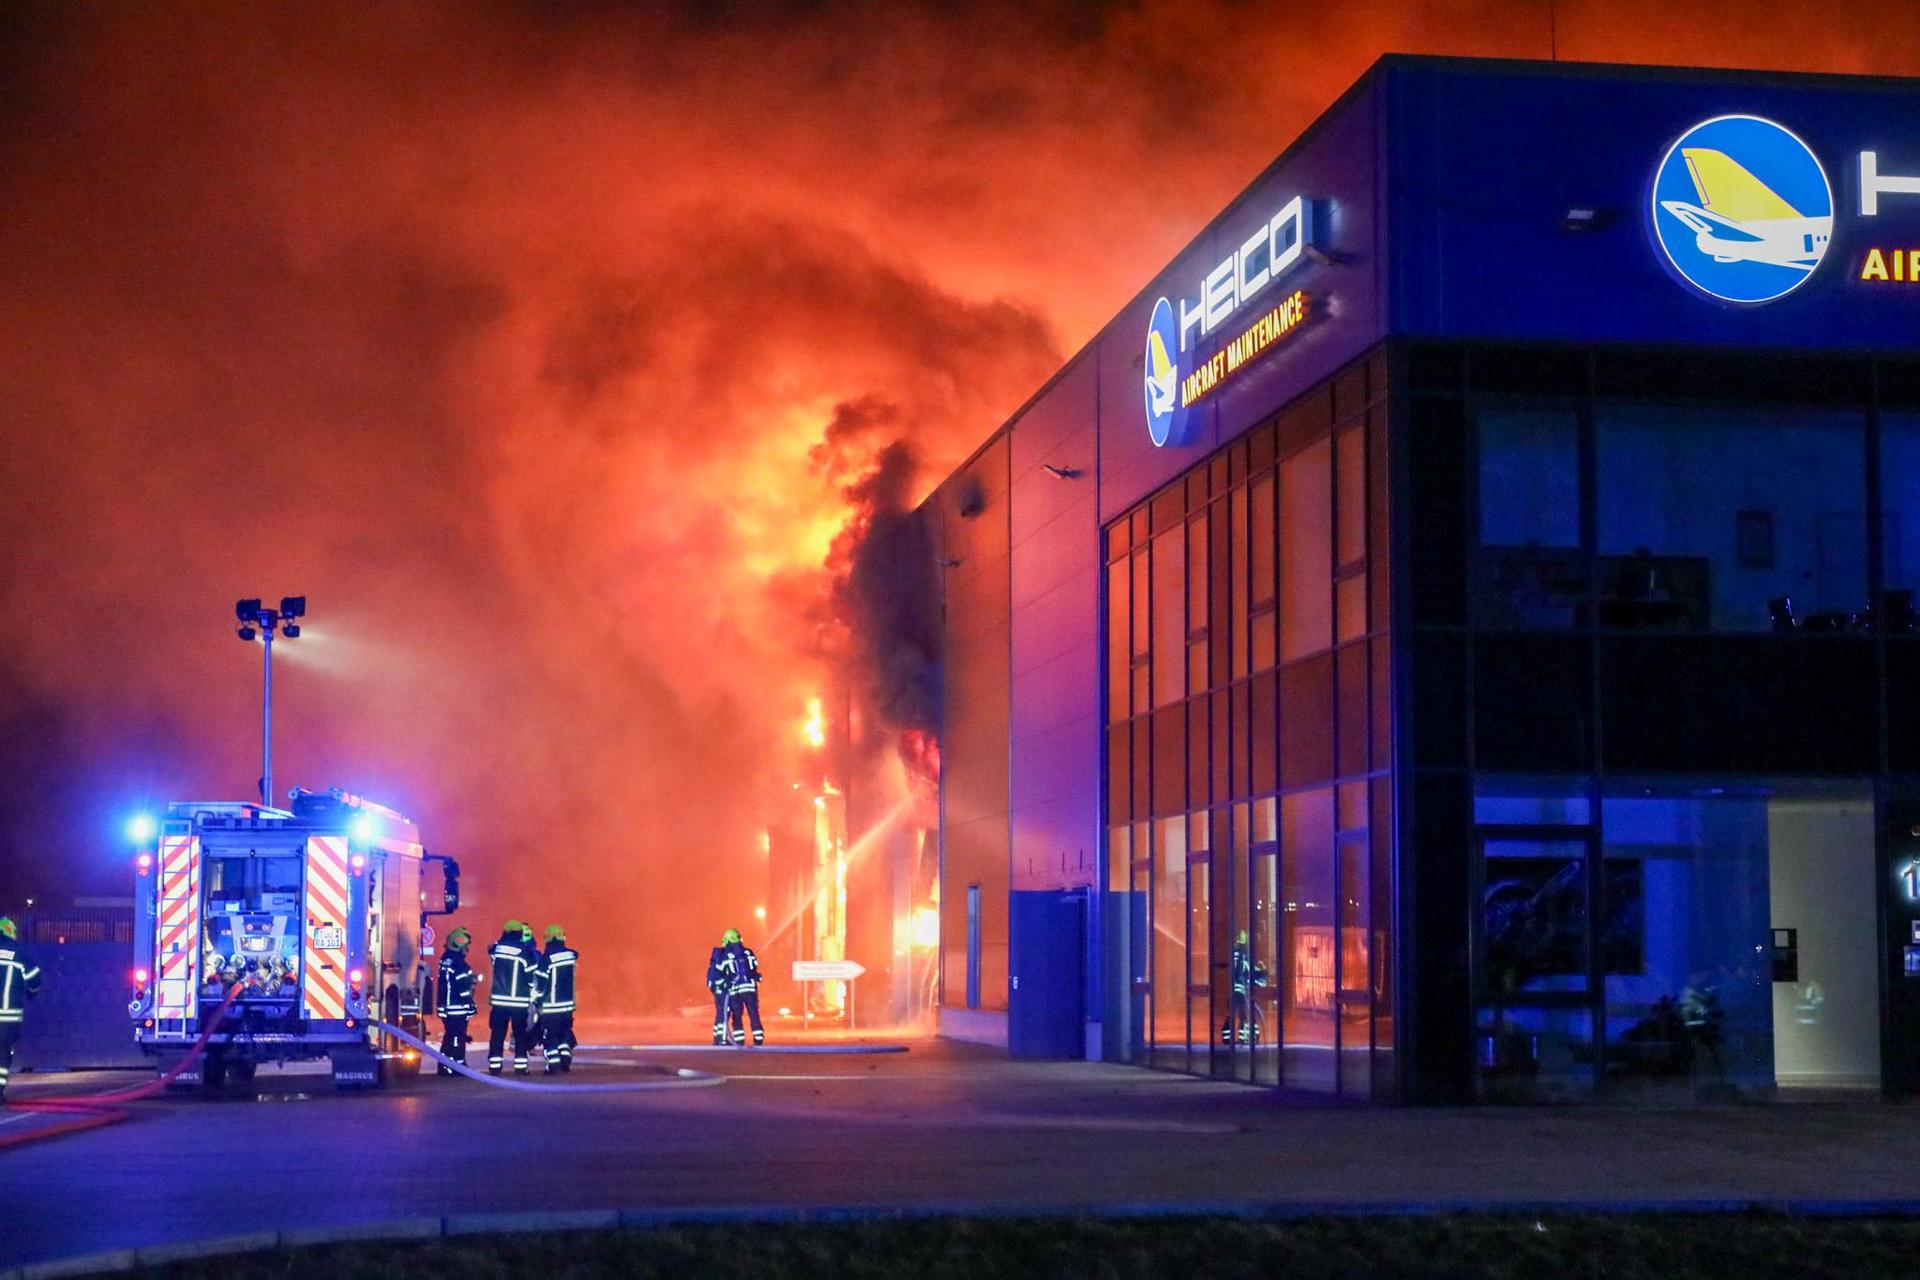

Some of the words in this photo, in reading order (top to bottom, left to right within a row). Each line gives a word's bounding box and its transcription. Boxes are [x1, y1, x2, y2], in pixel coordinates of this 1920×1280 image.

[1180, 196, 1302, 352] HEICO
[1181, 350, 1225, 408] AIRCRAFT
[1226, 290, 1303, 373] MAINTENANCE
[335, 1072, 374, 1080] MAGIRUS
